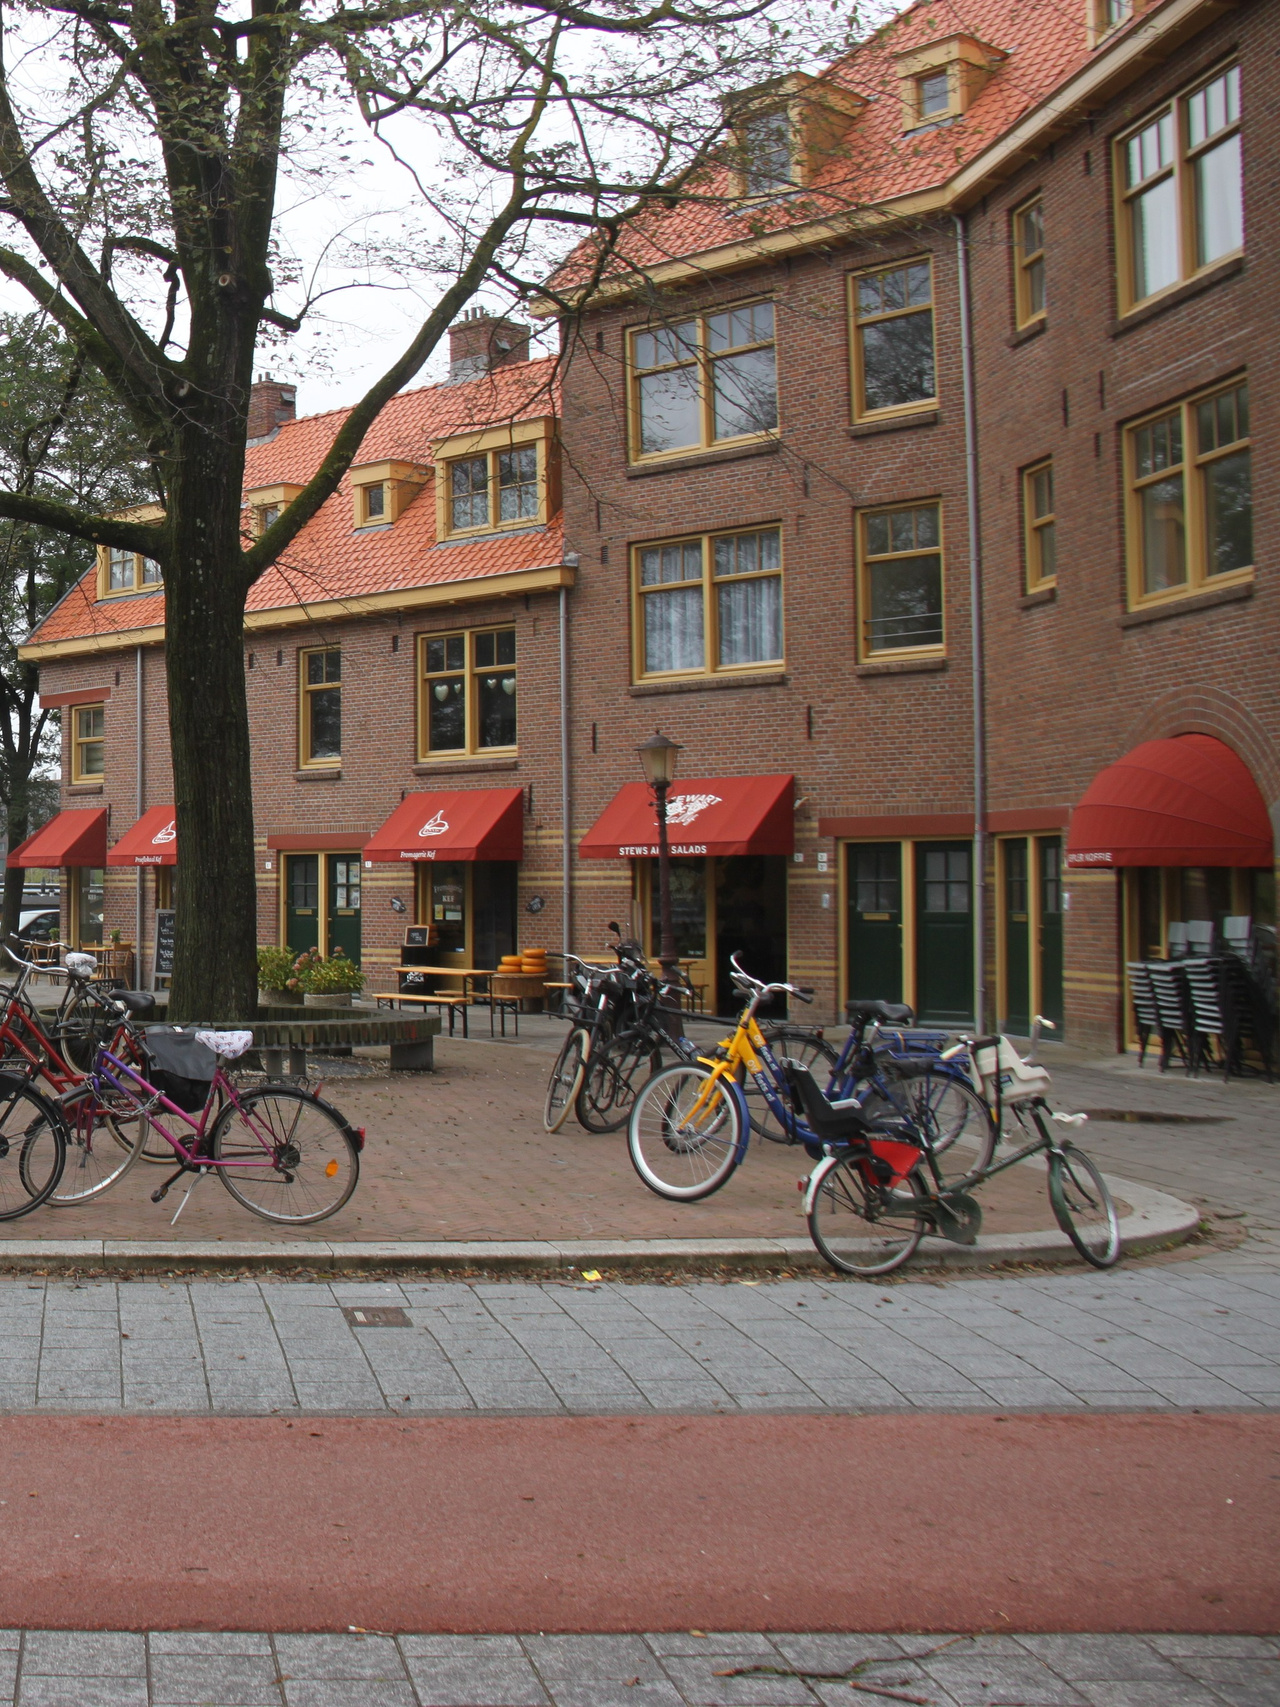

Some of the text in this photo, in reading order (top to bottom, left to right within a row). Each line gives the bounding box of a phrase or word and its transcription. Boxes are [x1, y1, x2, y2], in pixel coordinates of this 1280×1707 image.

[400, 850, 436, 859] Fromagerie Kef
[619, 846, 648, 856] STEWS
[671, 845, 707, 854] SALADS
[1084, 852, 1113, 862] KOFFIE
[658, 1028, 690, 1061] SANTOS
[747, 1060, 776, 1102] OV-fiets.nl
